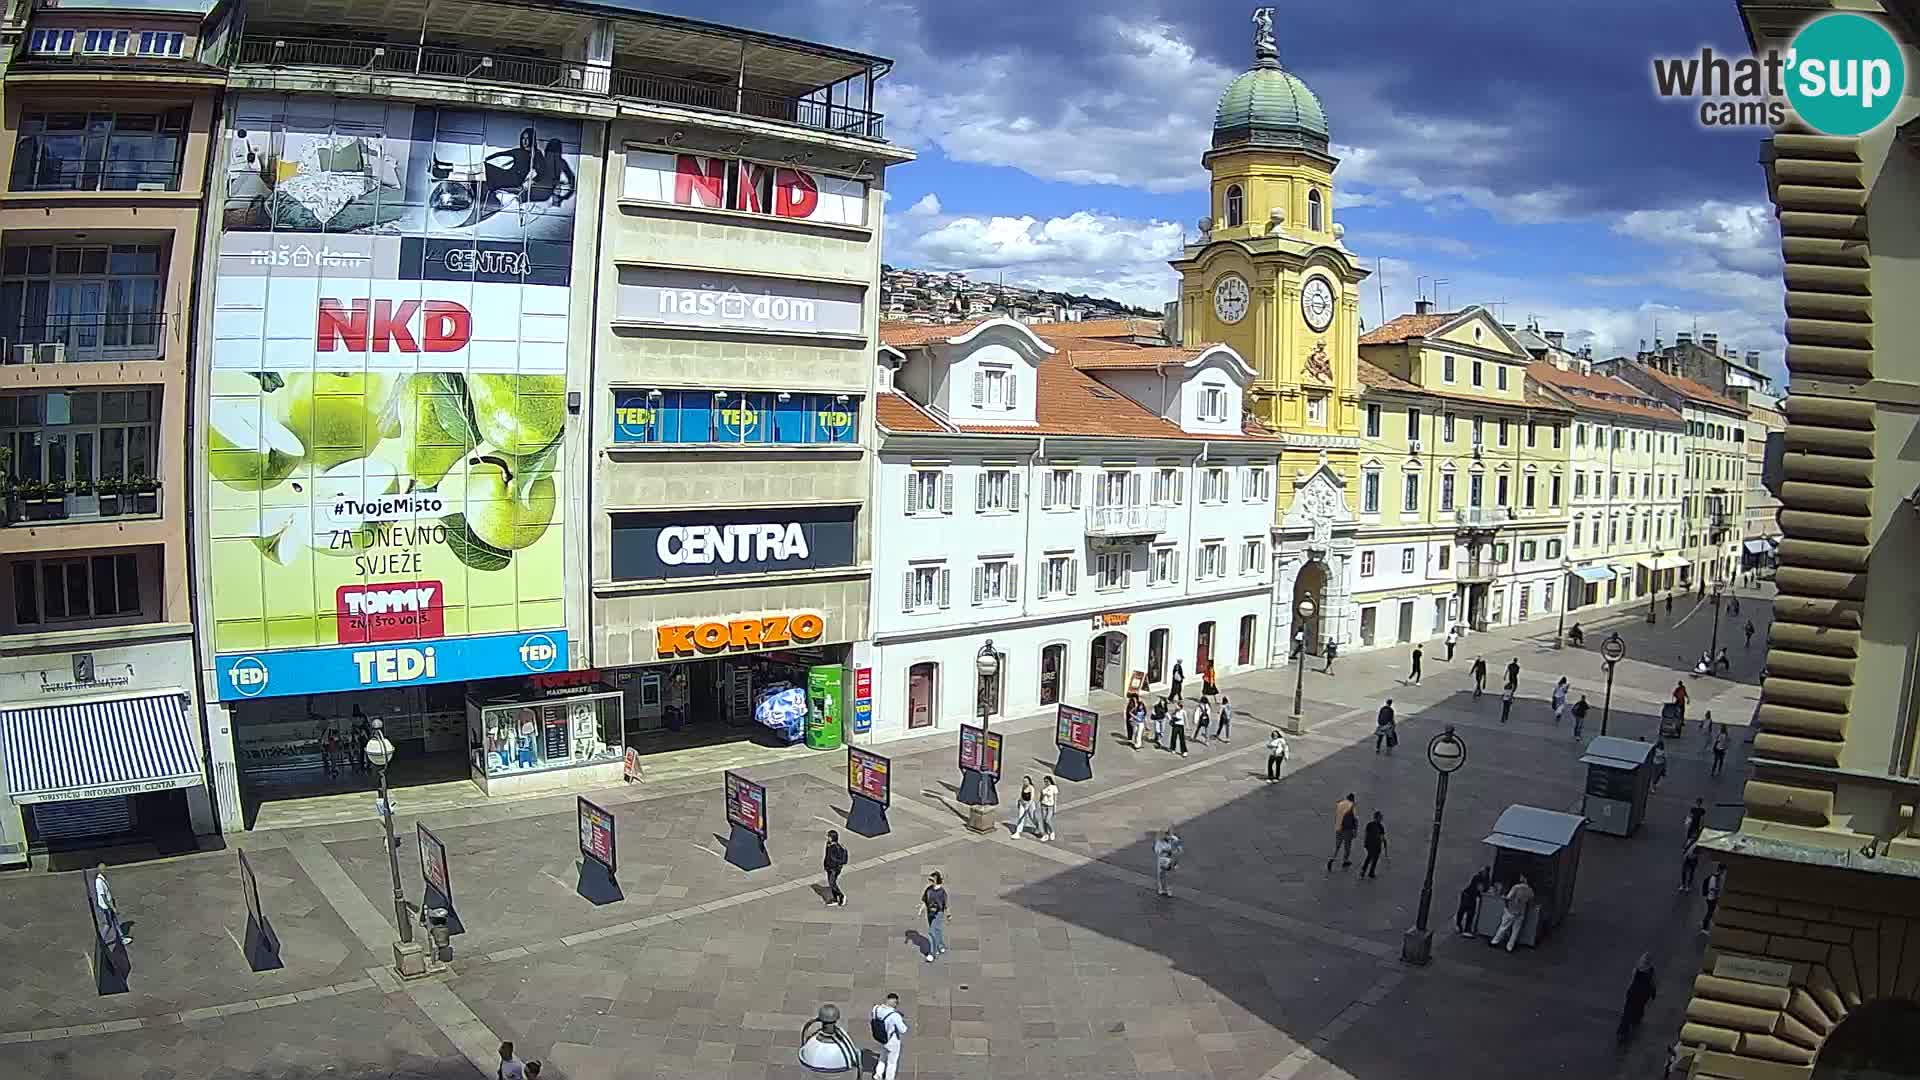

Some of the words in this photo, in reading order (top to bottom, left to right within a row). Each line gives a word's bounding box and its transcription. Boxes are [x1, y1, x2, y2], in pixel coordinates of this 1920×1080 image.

[674, 154, 818, 218] NKD
[250, 245, 290, 267] naš
[316, 244, 361, 268] dom
[444, 248, 532, 276] CENTRA
[659, 282, 715, 315] naš
[752, 290, 816, 322] dom
[317, 297, 472, 353] NKD
[616, 407, 657, 425] TEDi
[721, 409, 758, 426] TEDi
[818, 411, 852, 427] TEDi
[333, 497, 443, 520] #TvojeMisto
[330, 529, 354, 550] ZA
[361, 524, 448, 549] DNEVNO
[656, 522, 810, 566] CENTRA
[354, 552, 423, 576] SVJEŽE
[344, 587, 436, 616] TOMMY
[375, 615, 396, 627] ŠTO
[656, 614, 824, 659] KORZO
[353, 646, 438, 684] TEDi
[519, 642, 557, 663] TEDi
[228, 665, 269, 685] TEDi
